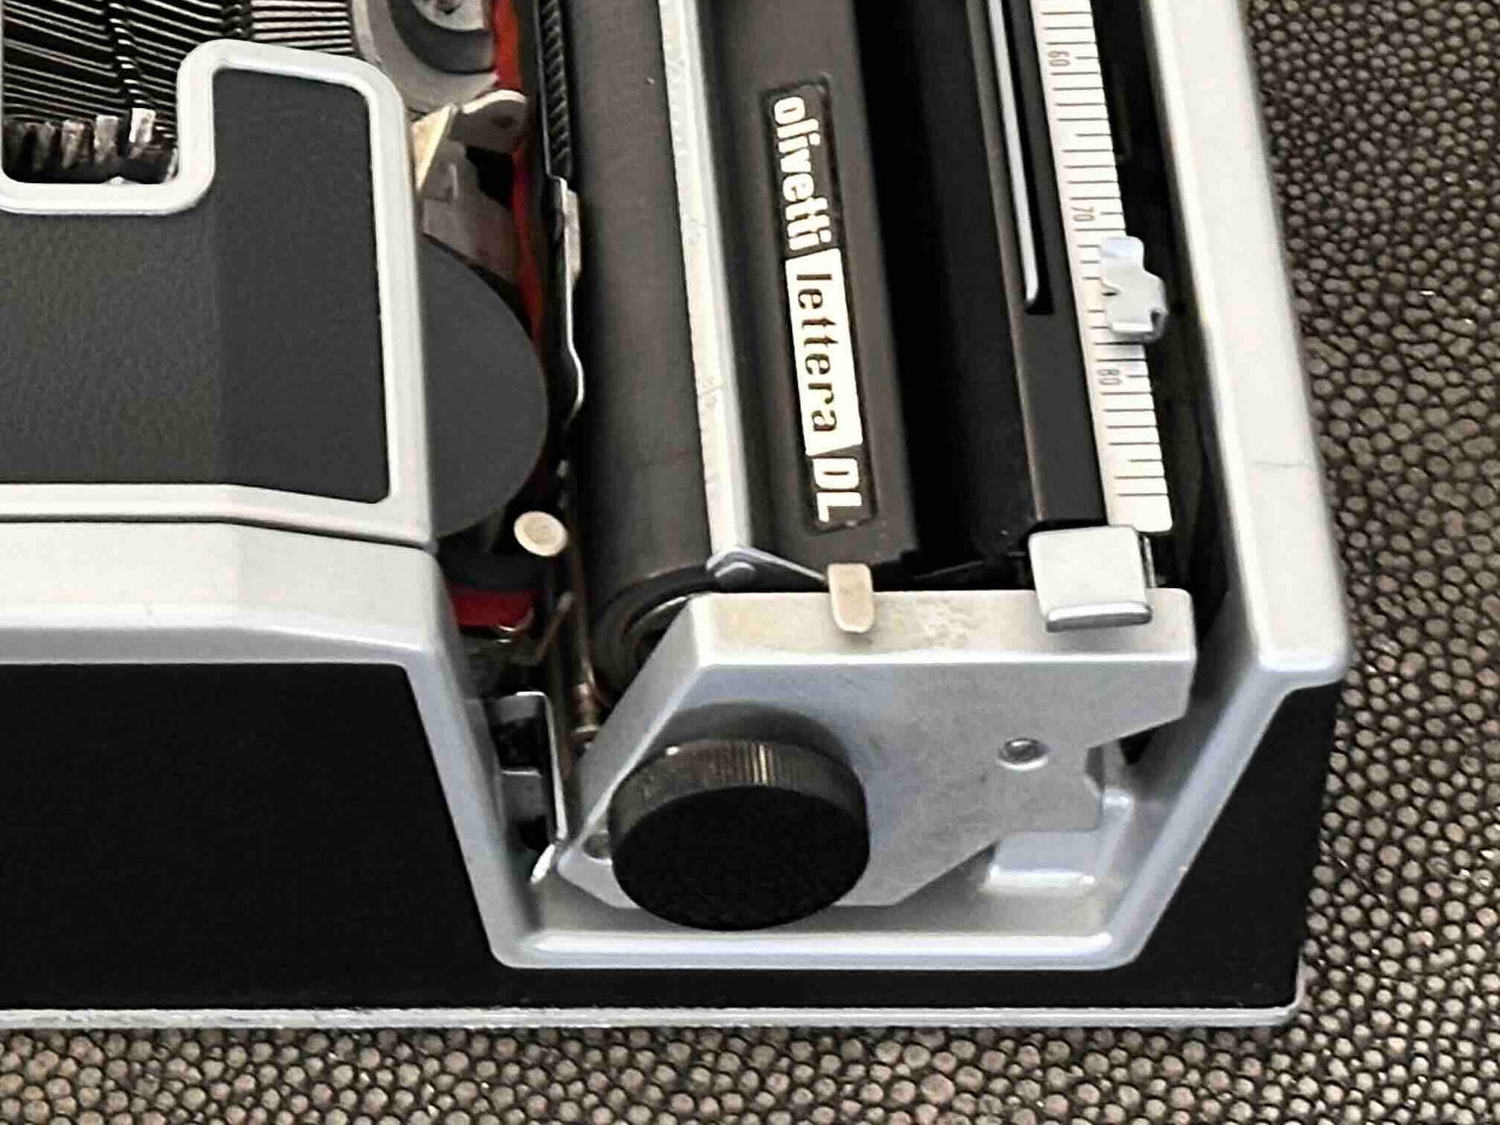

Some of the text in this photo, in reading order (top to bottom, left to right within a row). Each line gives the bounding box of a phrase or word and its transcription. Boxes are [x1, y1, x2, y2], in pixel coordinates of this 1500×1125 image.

[773, 96, 862, 523] olivetti lettera DL
[1048, 49, 1071, 67] 60
[1071, 206, 1096, 222] 70
[1097, 368, 1122, 386] 80
